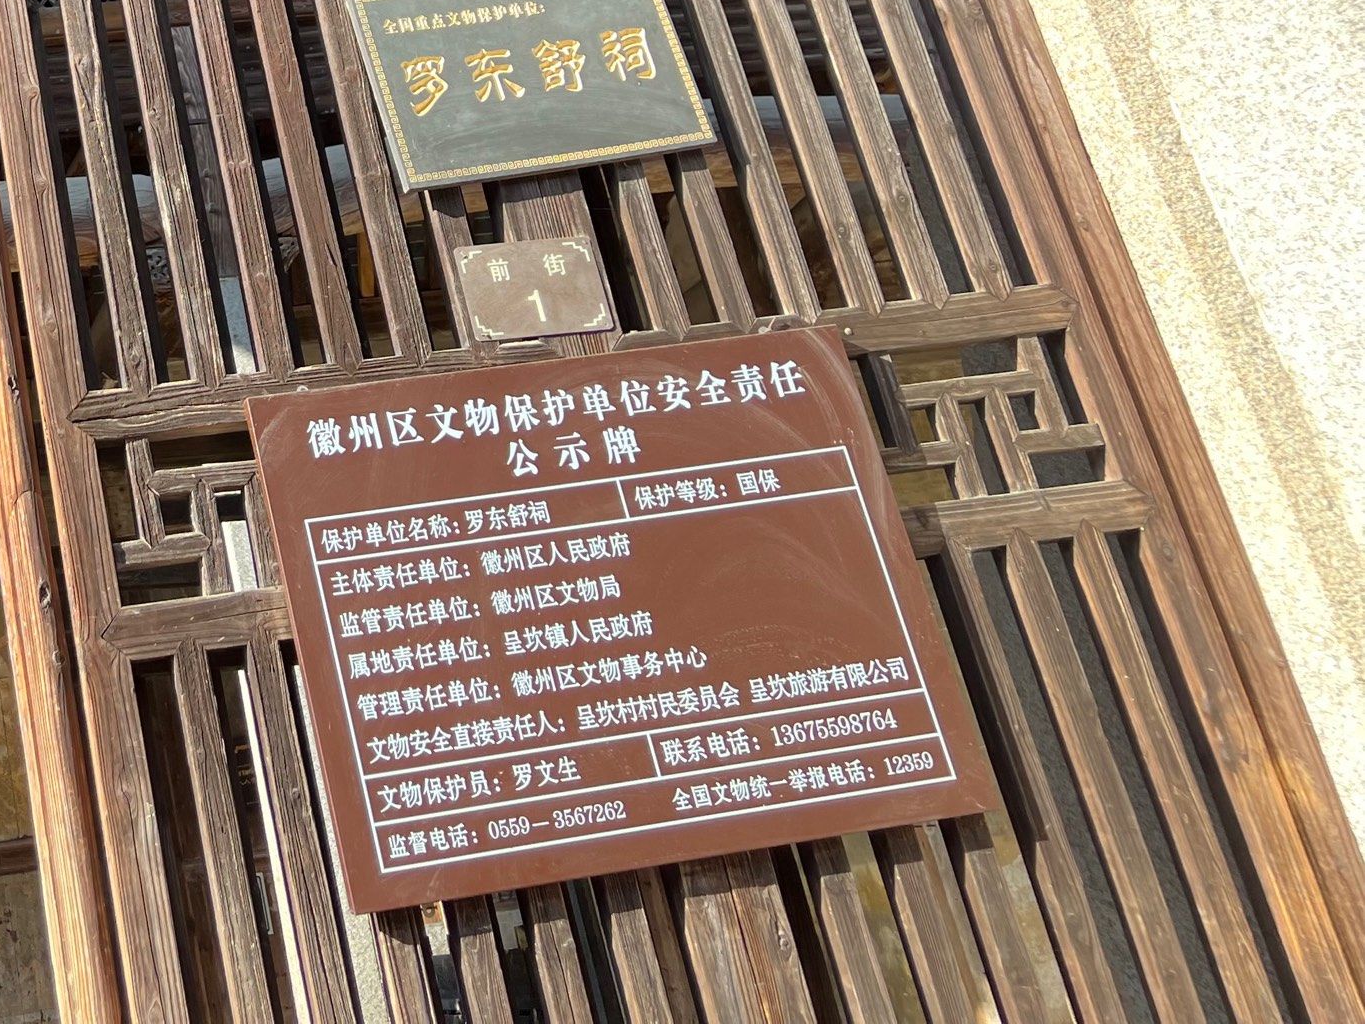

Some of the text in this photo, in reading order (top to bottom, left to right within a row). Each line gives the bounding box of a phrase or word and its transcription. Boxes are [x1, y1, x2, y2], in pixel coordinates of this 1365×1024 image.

[401, 28, 656, 117] 罗东舒祠
[486, 253, 567, 283] 前街
[528, 289, 547, 322] 1
[307, 360, 805, 458] 徽州区文物保护单位安全责任
[507, 426, 641, 476] 公示牌
